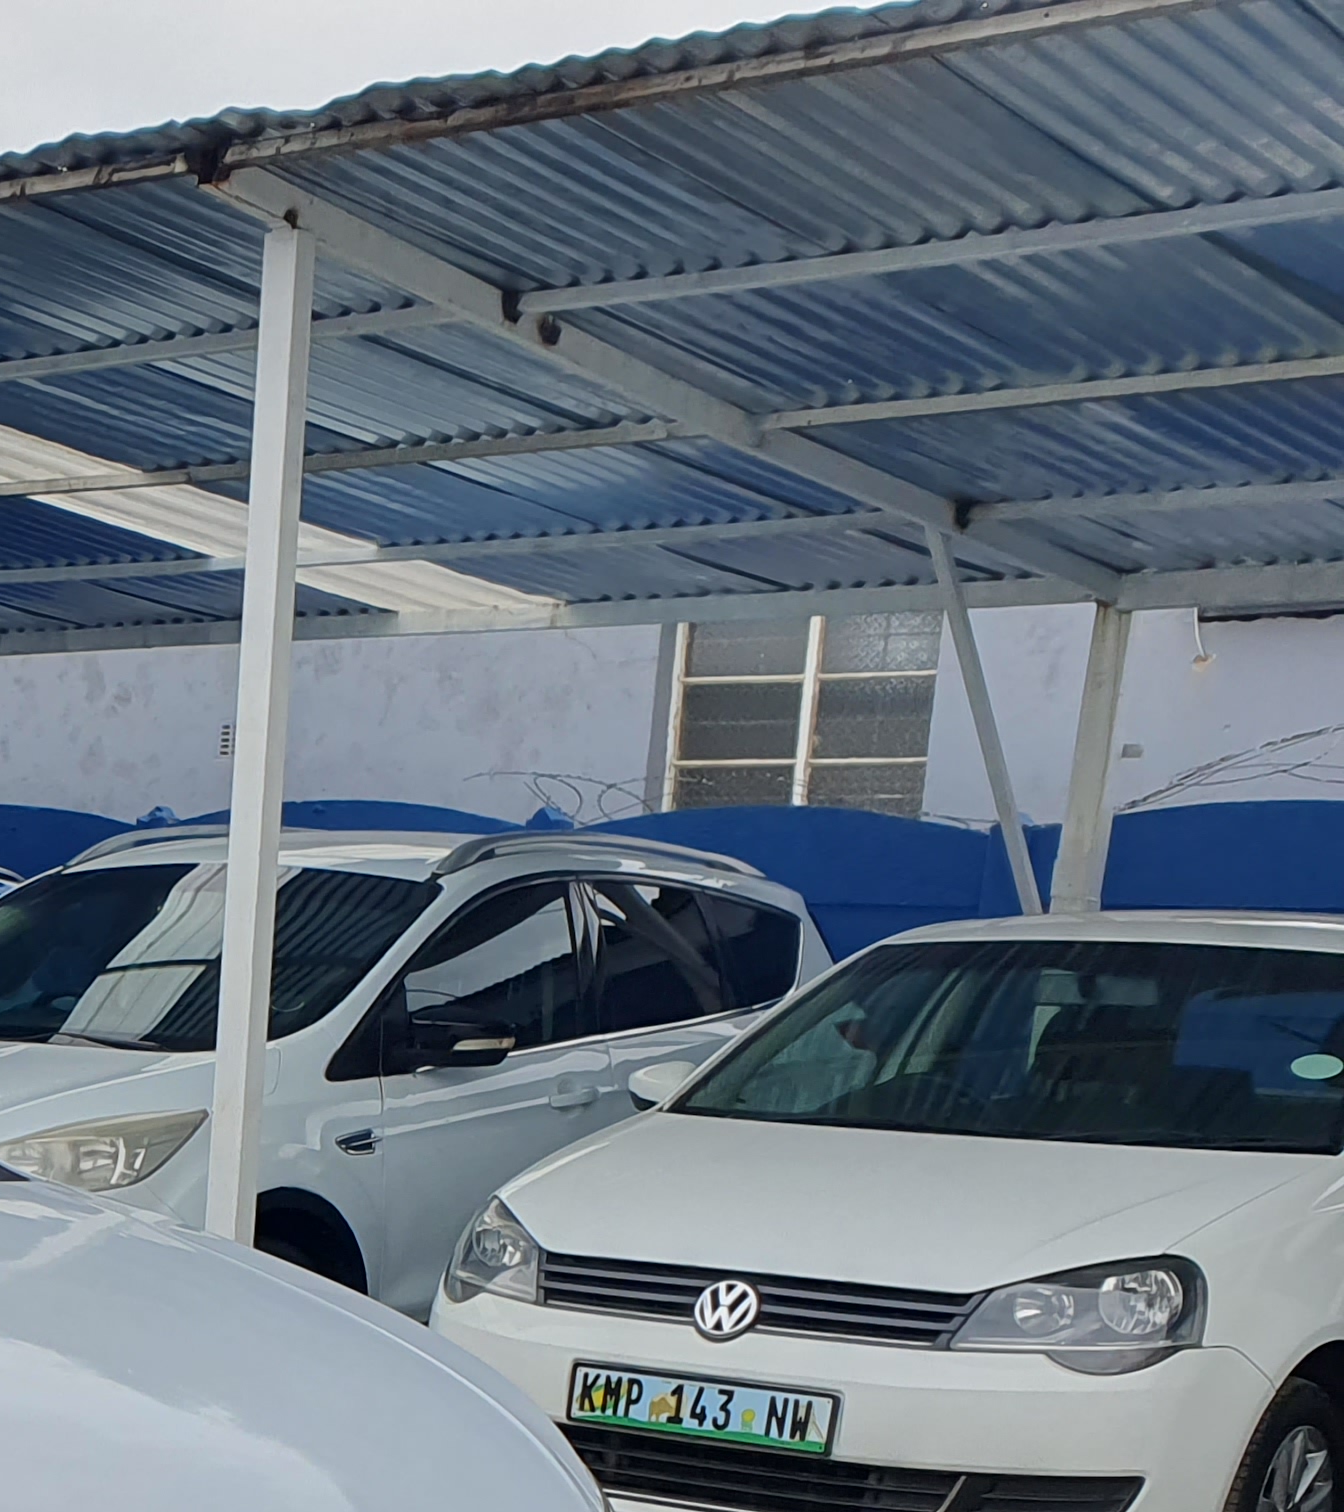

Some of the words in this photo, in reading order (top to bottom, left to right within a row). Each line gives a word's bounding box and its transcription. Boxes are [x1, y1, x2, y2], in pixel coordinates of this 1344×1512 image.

[579, 1371, 643, 1418] KMP
[666, 1384, 735, 1431] 143
[764, 1396, 813, 1441] NW
